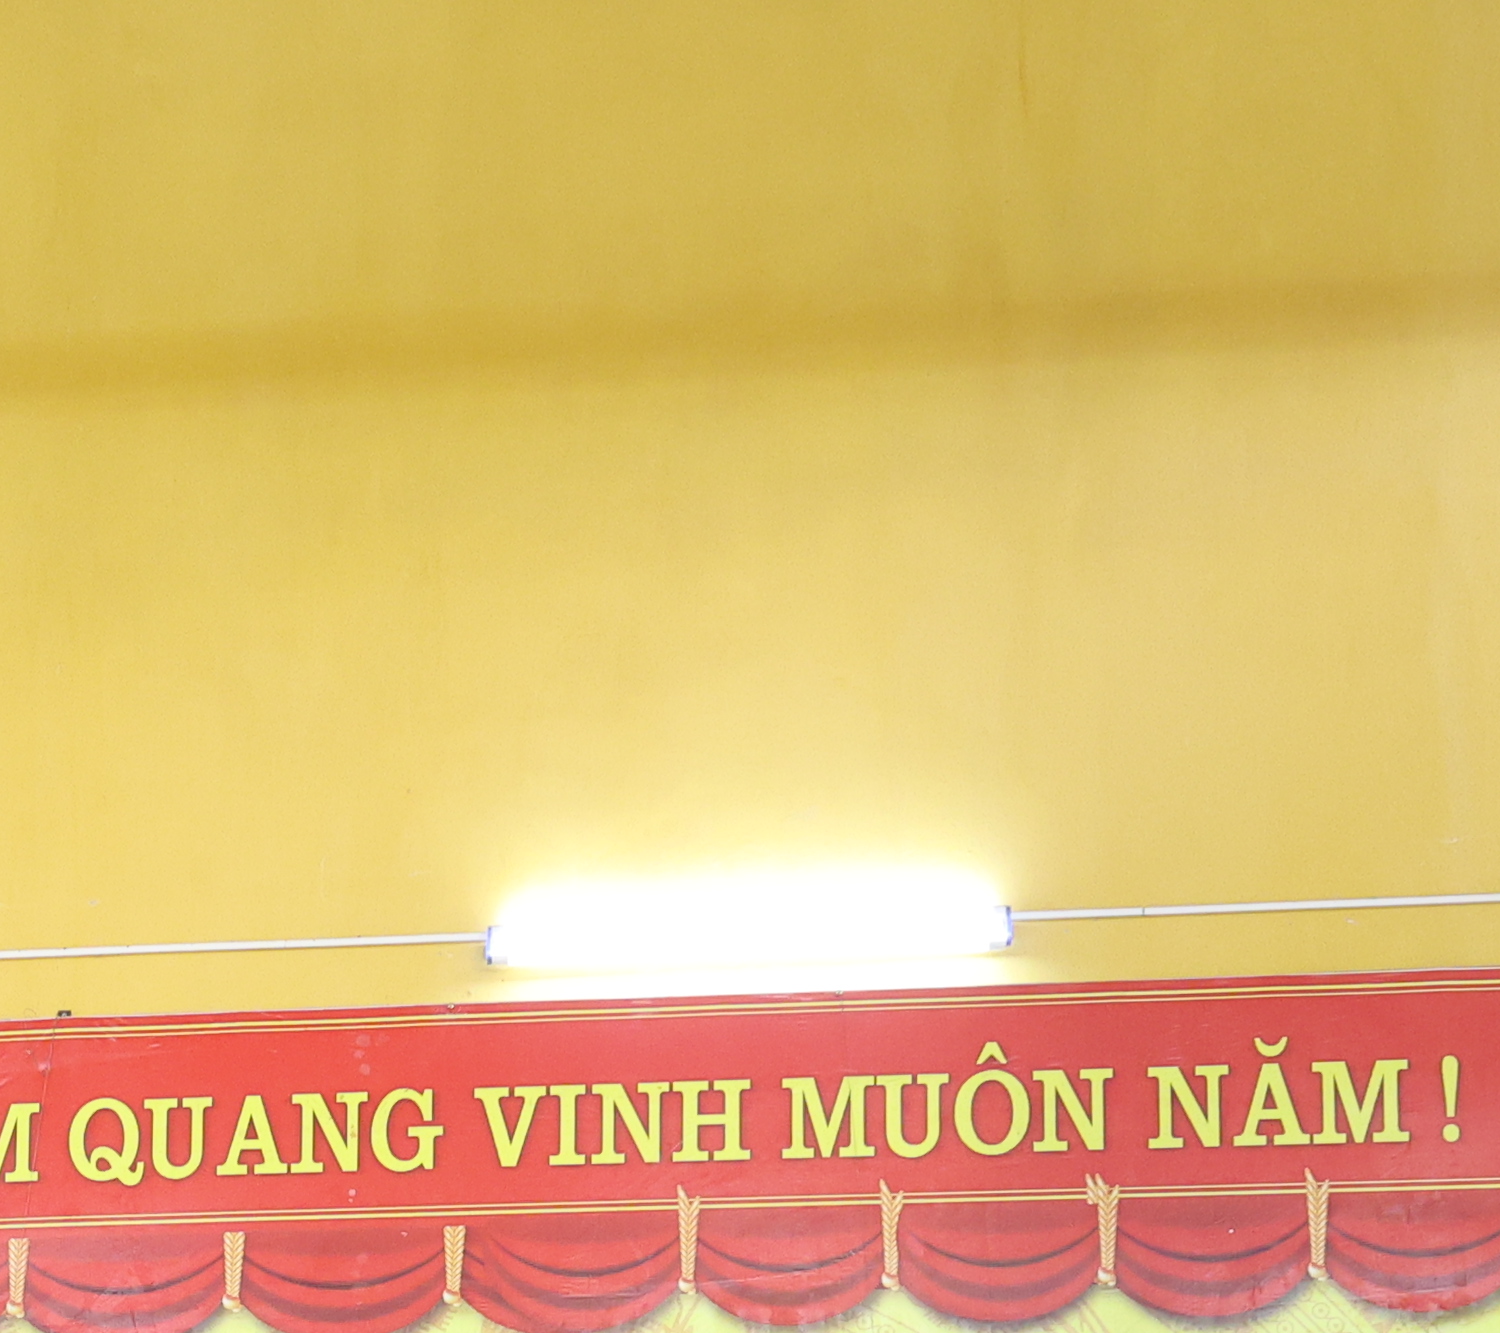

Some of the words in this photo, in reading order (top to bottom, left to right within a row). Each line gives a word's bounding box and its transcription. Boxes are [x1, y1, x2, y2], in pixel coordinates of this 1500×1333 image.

[65, 1085, 444, 1186] QUANG
[474, 1078, 753, 1170] VINH
[780, 1042, 1114, 1156] MUÔN
[1146, 1037, 1412, 1149] NĂM
[1441, 1056, 1463, 1140] !
